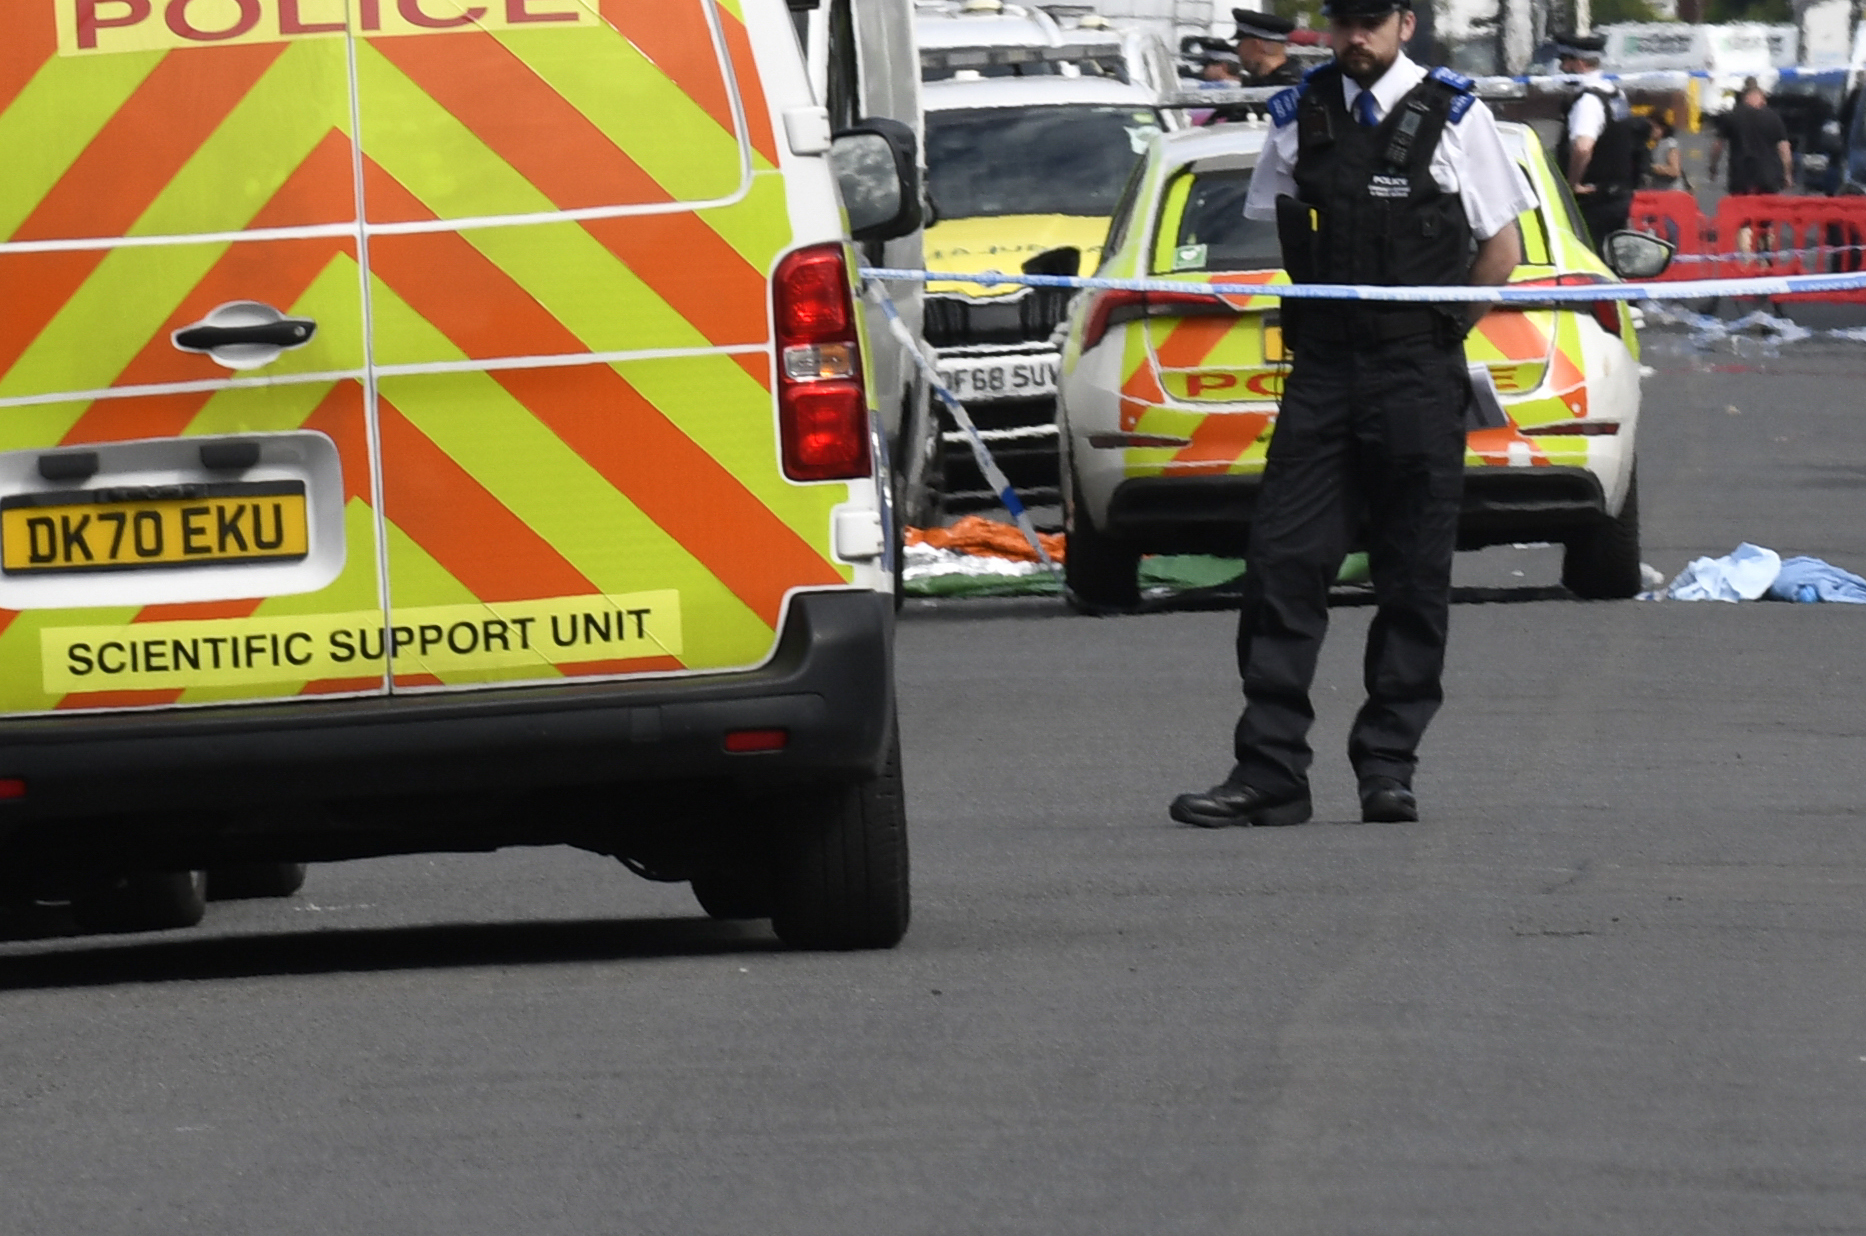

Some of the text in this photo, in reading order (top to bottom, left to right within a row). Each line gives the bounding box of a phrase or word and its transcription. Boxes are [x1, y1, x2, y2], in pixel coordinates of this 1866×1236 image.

[26, 503, 283, 564] DK70 EKU
[67, 608, 651, 676] SCIENTIFIC SUPPORT UNIT
